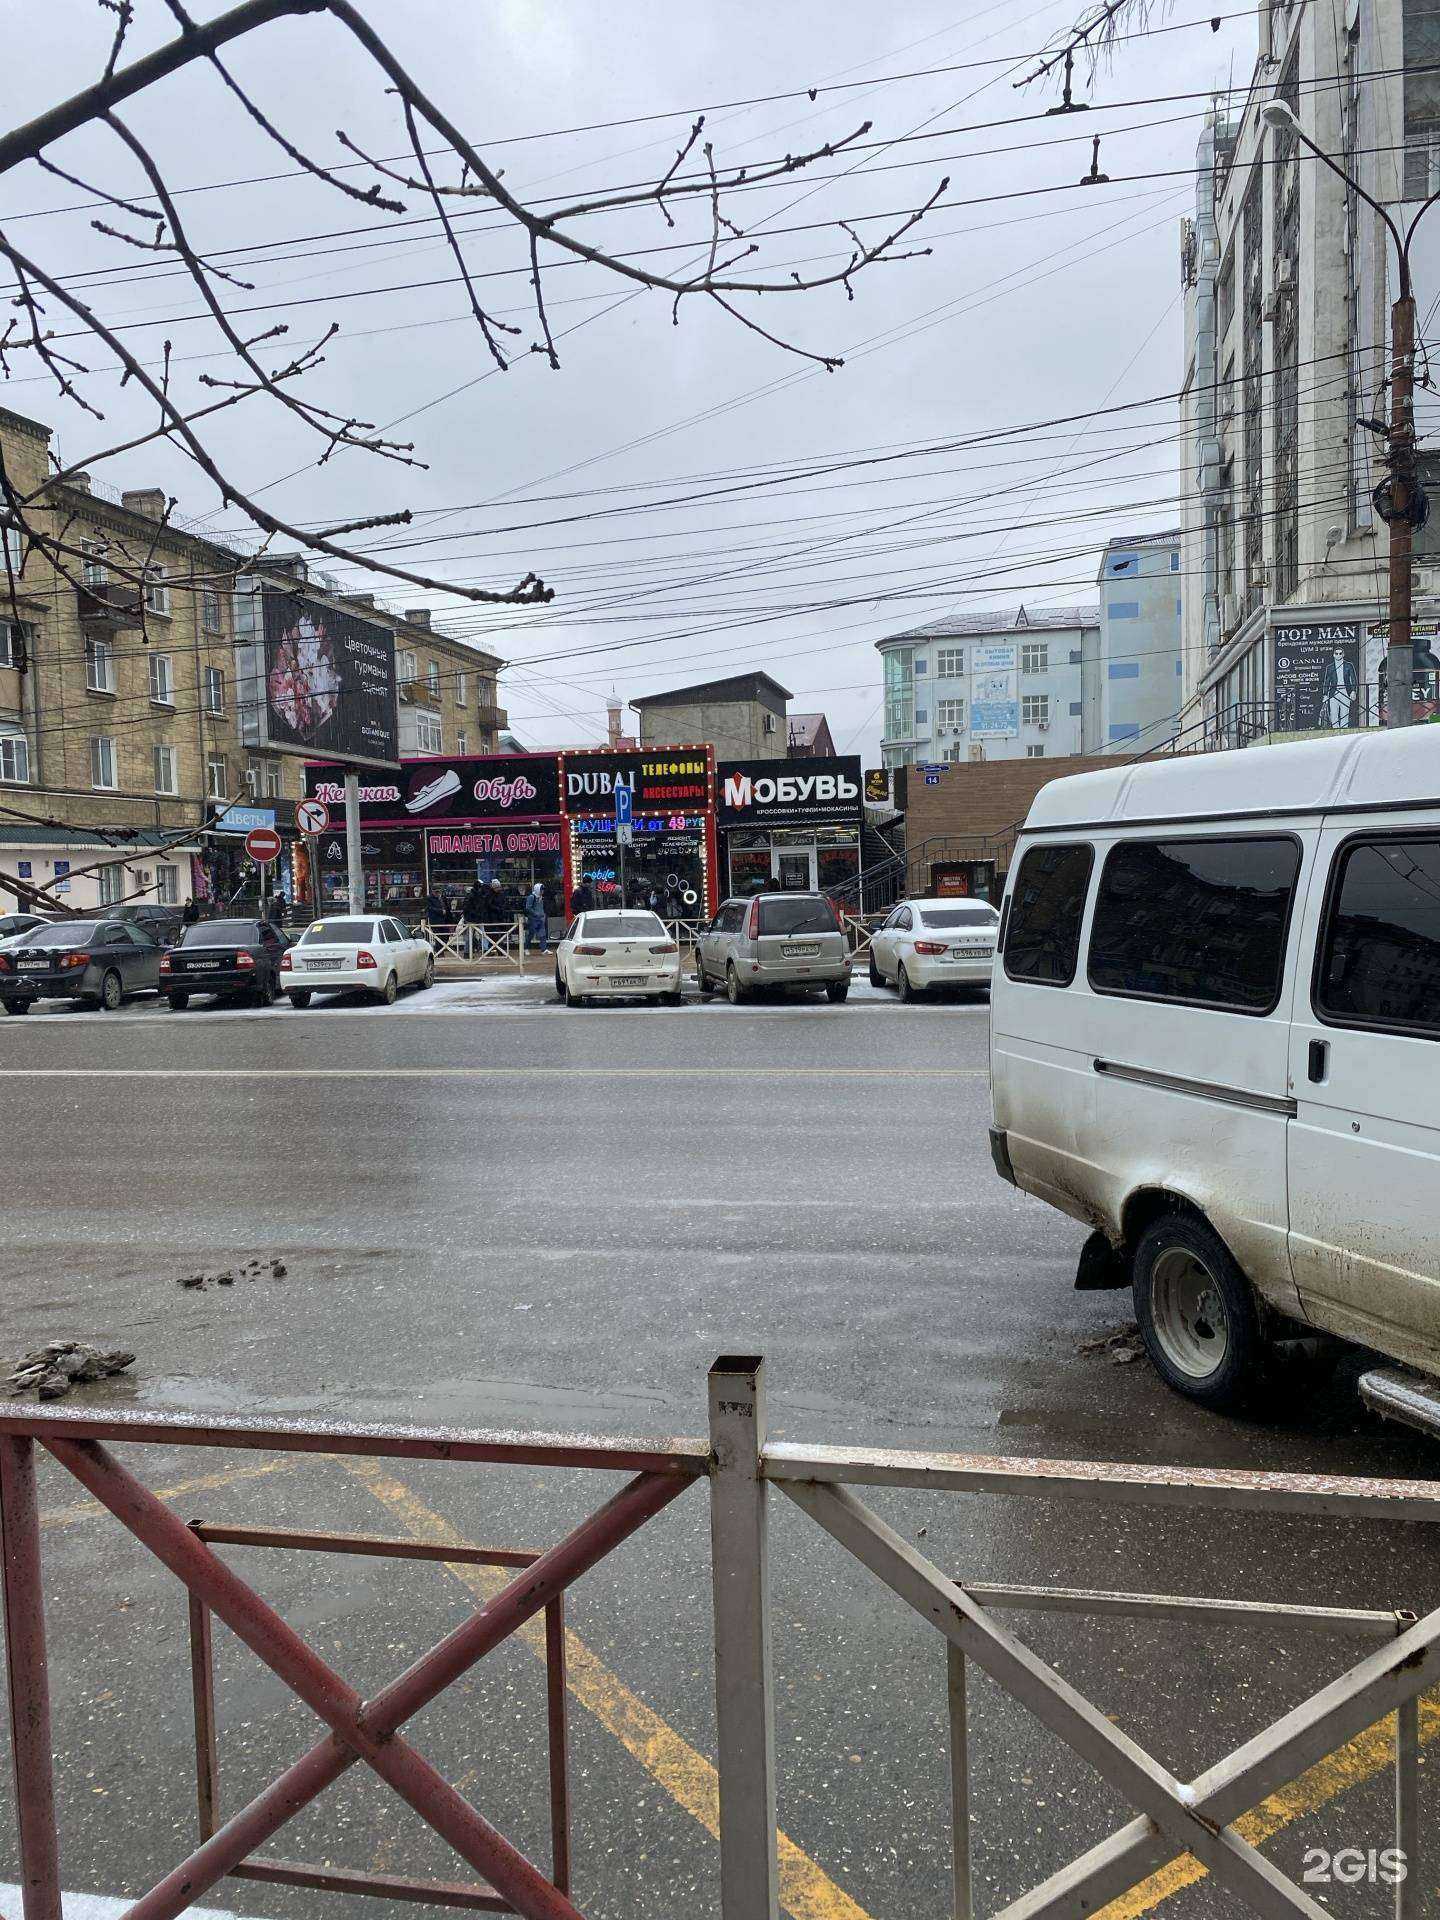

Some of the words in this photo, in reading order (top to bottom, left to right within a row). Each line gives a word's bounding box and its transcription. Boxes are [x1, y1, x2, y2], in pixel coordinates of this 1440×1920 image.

[1278, 629, 1312, 642] TOP
[1317, 626, 1357, 640] MAN
[354, 660, 388, 680] гурманы
[641, 762, 704, 776] ТЕЛЕФОНЫ
[566, 771, 637, 796] DUBAI
[927, 776, 938, 784] 14
[474, 775, 537, 808] Обувь
[642, 784, 705, 800] АКСЕССУАРЫ
[226, 811, 267, 826] Цветы
[430, 834, 503, 854] ПЛАНЕТА
[506, 832, 560, 852] ОБУВИ
